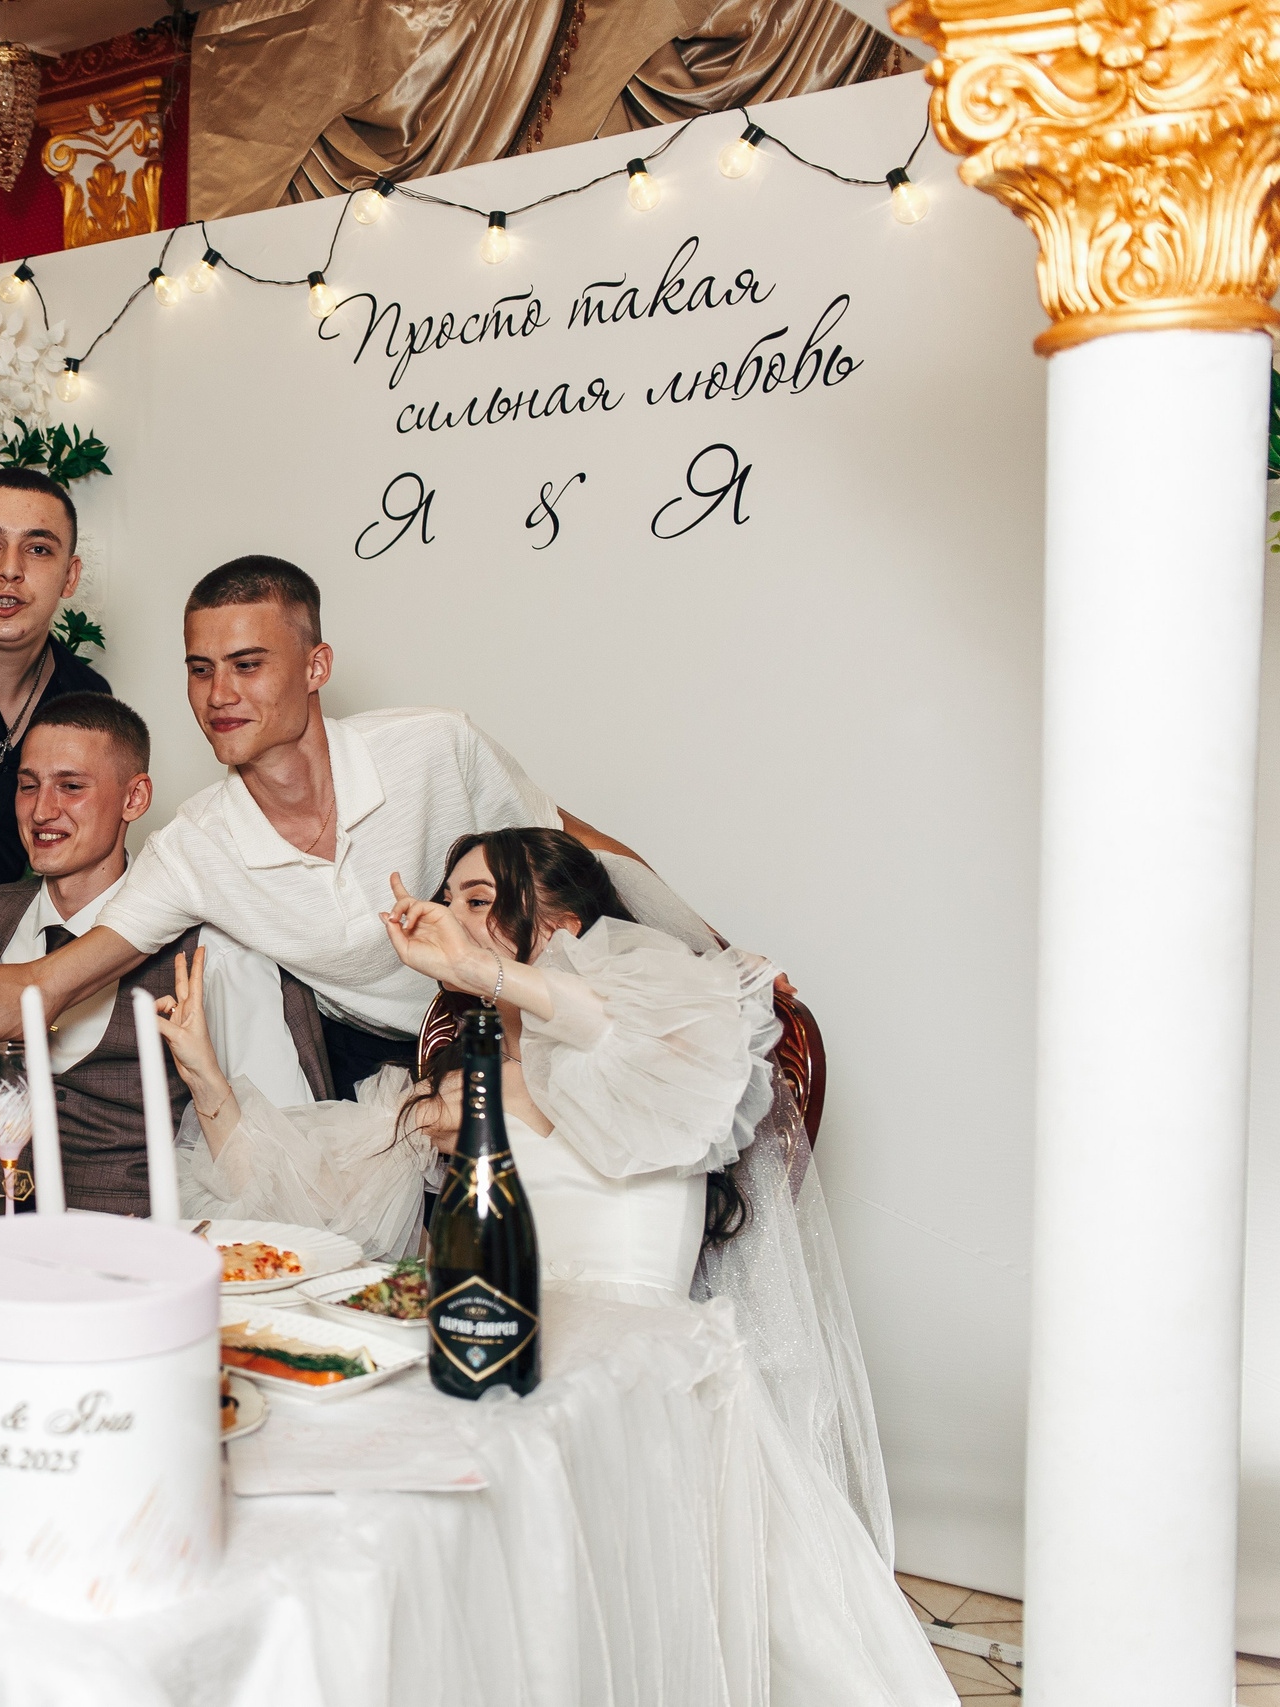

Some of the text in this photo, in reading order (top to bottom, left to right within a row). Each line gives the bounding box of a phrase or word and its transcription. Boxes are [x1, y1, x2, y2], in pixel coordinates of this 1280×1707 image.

[318, 235, 777, 390] Просто такая
[395, 293, 865, 434] сильная любовь
[354, 443, 753, 560] Я & Я
